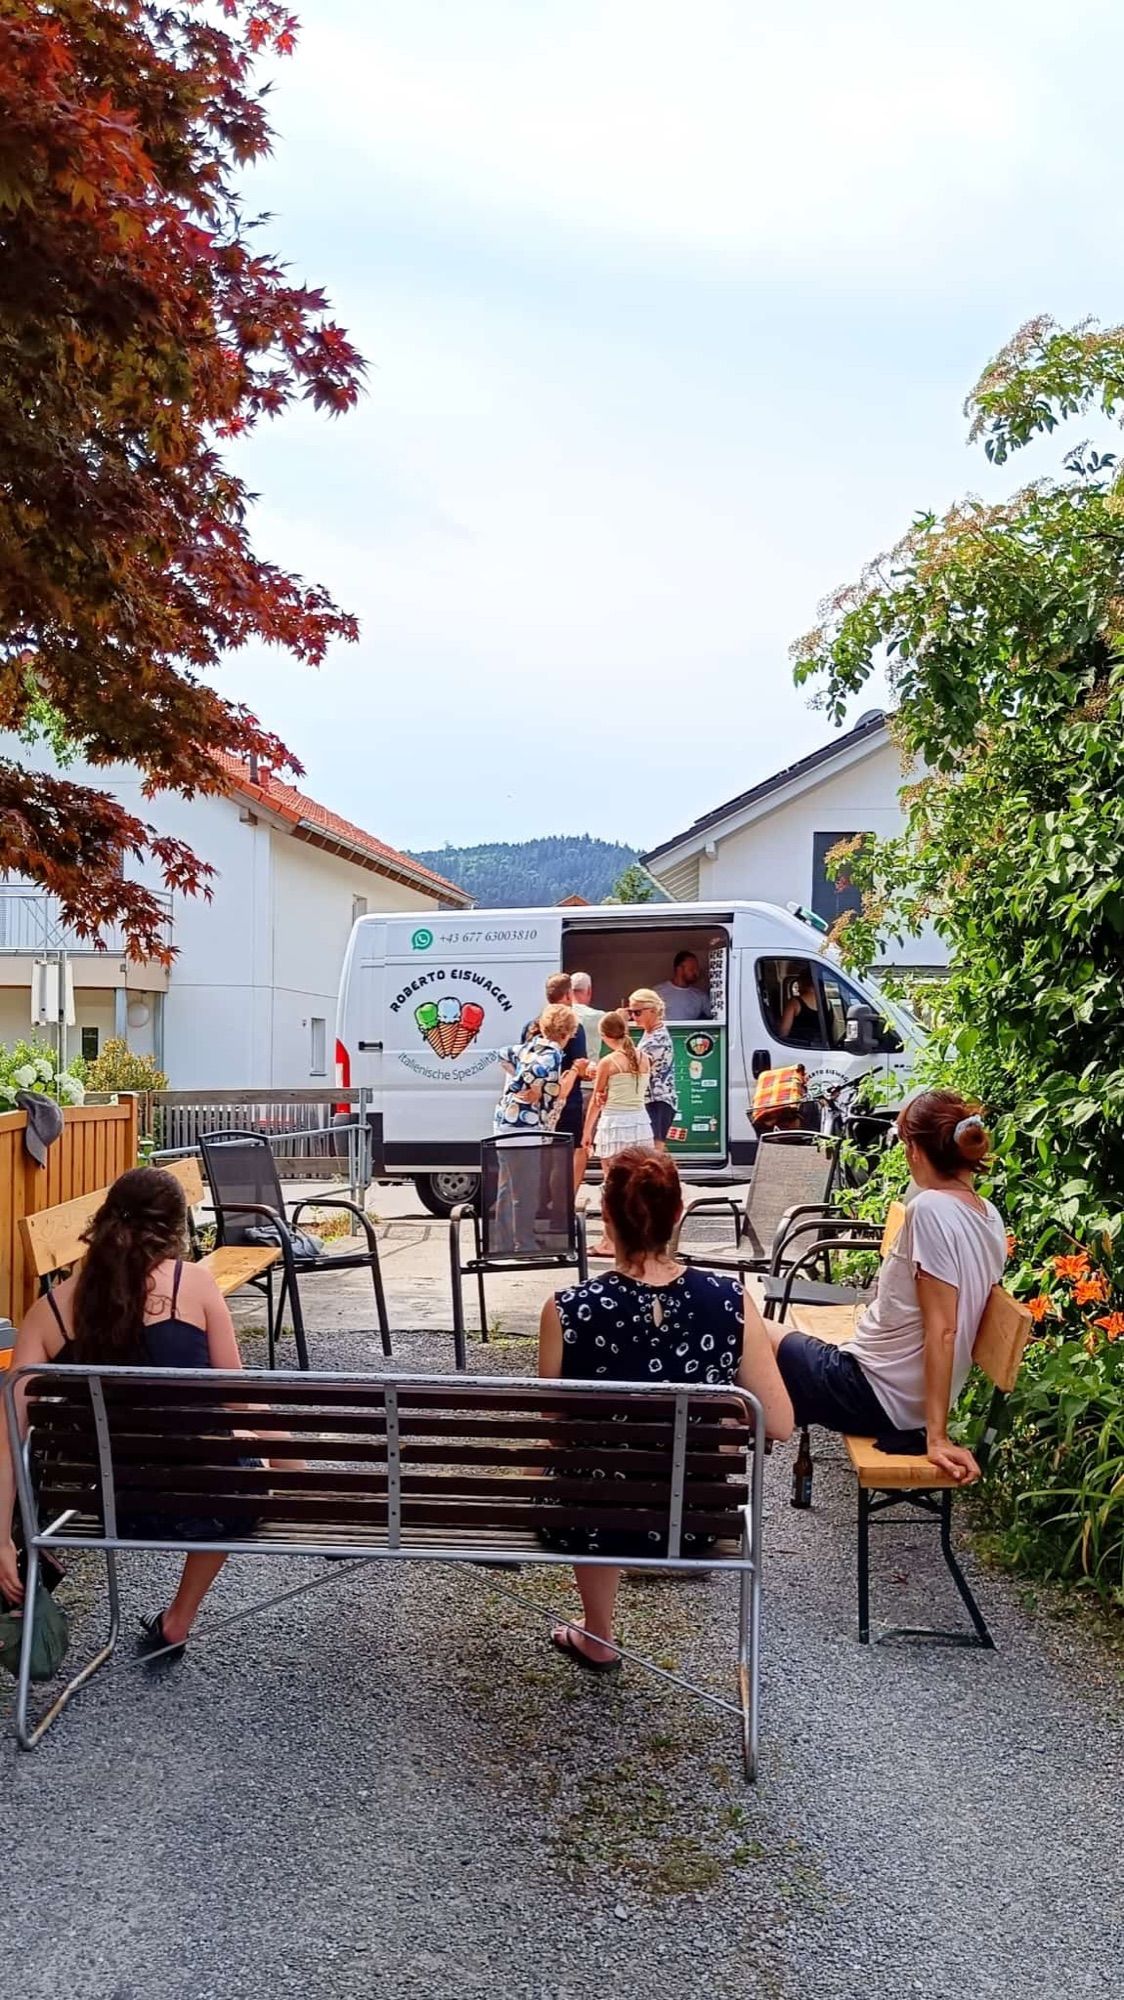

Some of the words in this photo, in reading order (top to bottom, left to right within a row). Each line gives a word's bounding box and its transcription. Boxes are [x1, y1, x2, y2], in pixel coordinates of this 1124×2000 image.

[439, 932, 459, 944] +43
[462, 931, 483, 943] 677
[484, 929, 538, 942] 63003810
[389, 969, 446, 1013] ROBERTO
[450, 968, 513, 1012] EISWAGEN
[398, 1051, 451, 1081] Italienische
